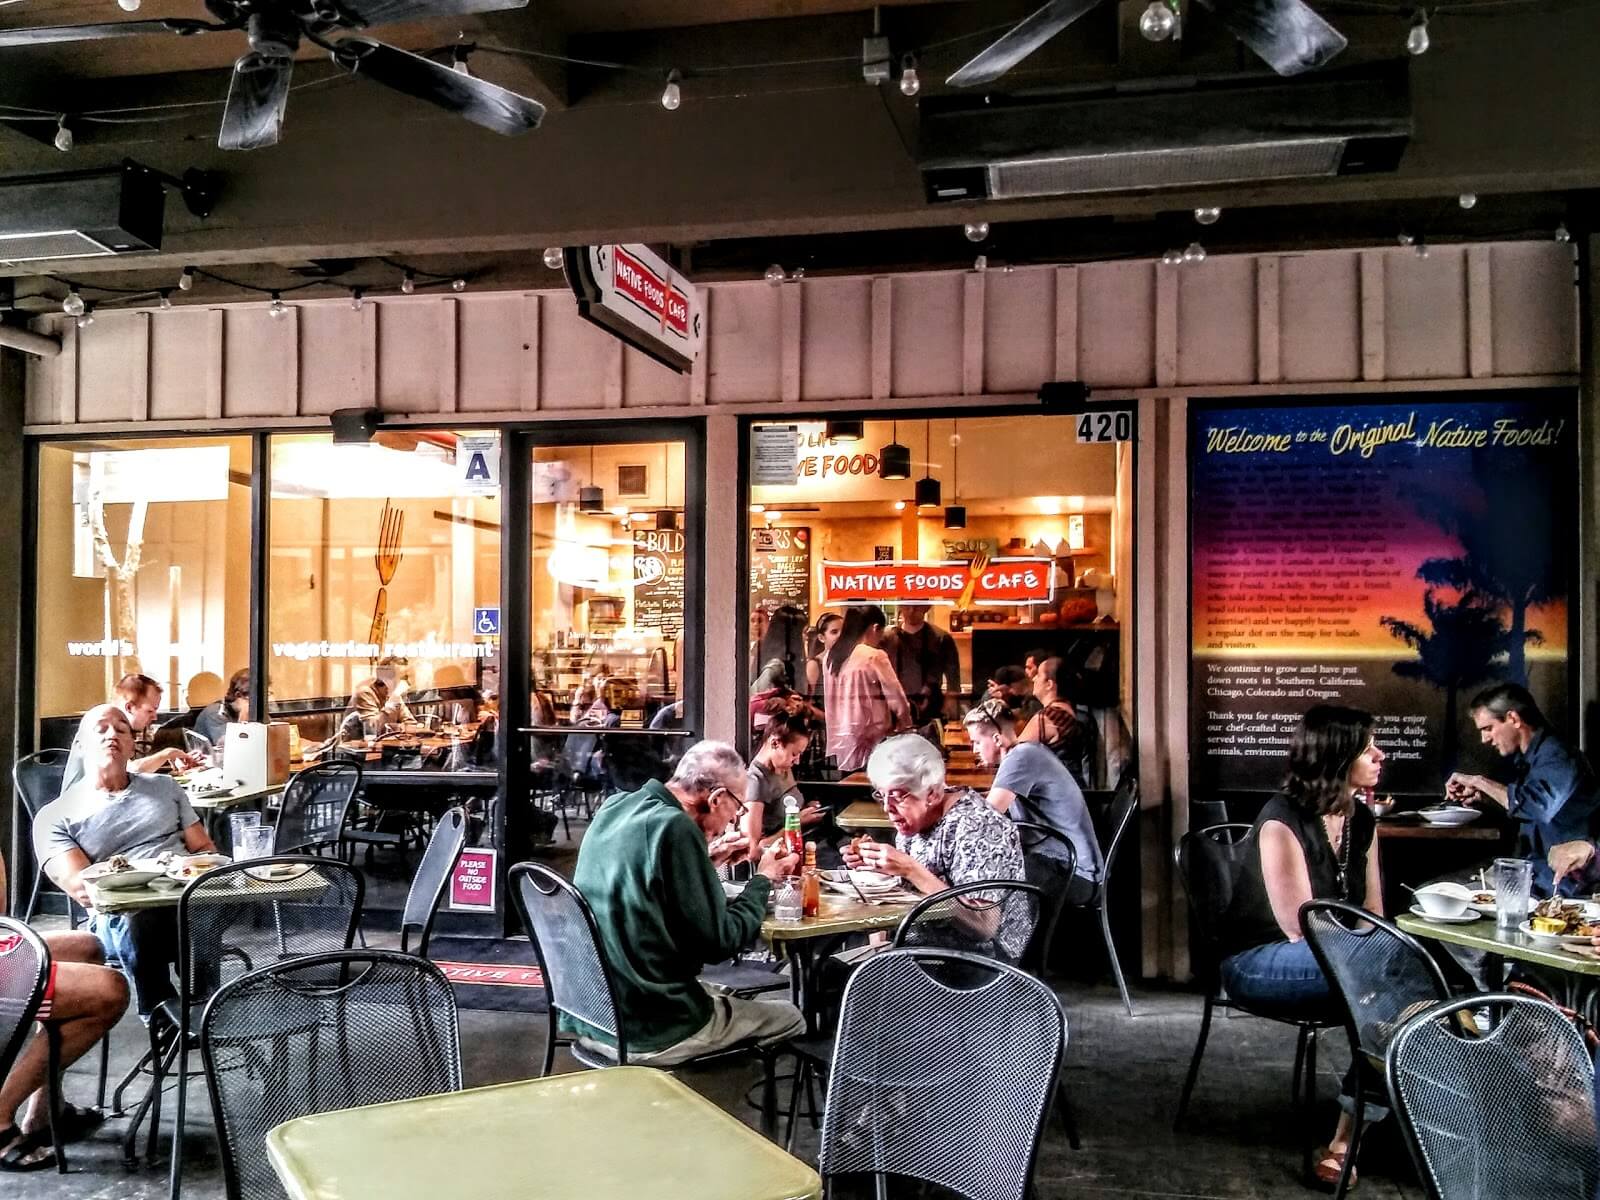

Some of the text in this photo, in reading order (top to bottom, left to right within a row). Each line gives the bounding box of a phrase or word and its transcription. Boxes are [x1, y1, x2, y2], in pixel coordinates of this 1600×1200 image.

[616, 259, 642, 292] NATIVE
[644, 281, 664, 308] FOODS
[1078, 413, 1130, 441] 420
[1207, 411, 1564, 458] Welcome to the Original Native Foods!
[465, 450, 491, 479] A
[822, 453, 880, 479] FOOD
[647, 532, 684, 553] BOLD
[831, 575, 896, 591] NATIVE
[904, 575, 963, 590] FOODS
[272, 640, 380, 661] vegetarian
[1207, 664, 1358, 675] We continue to grow and have put
[1207, 676, 1231, 685] down
[1235, 676, 1257, 685] roots
[1262, 676, 1271, 685] in
[1275, 676, 1315, 685] Southern
[1246, 688, 1286, 697] Colorado
[1288, 688, 1304, 698] and
[1306, 688, 1341, 699] Oregon.
[1207, 711, 1234, 720] Thank
[1237, 713, 1253, 722] you
[1256, 711, 1268, 720] for
[1383, 716, 1400, 725] you
[1403, 715, 1427, 725] enjoy
[1226, 723, 1277, 732] chef-crafted
[1373, 726, 1400, 734] cratch
[1207, 735, 1235, 744] served
[1237, 735, 1256, 744] with
[1412, 738, 1427, 747] the
[1392, 750, 1422, 760] planet.
[460, 860, 487, 869] PLEASE
[458, 875, 488, 884] OUTSIDE
[462, 882, 482, 891] FOOD
